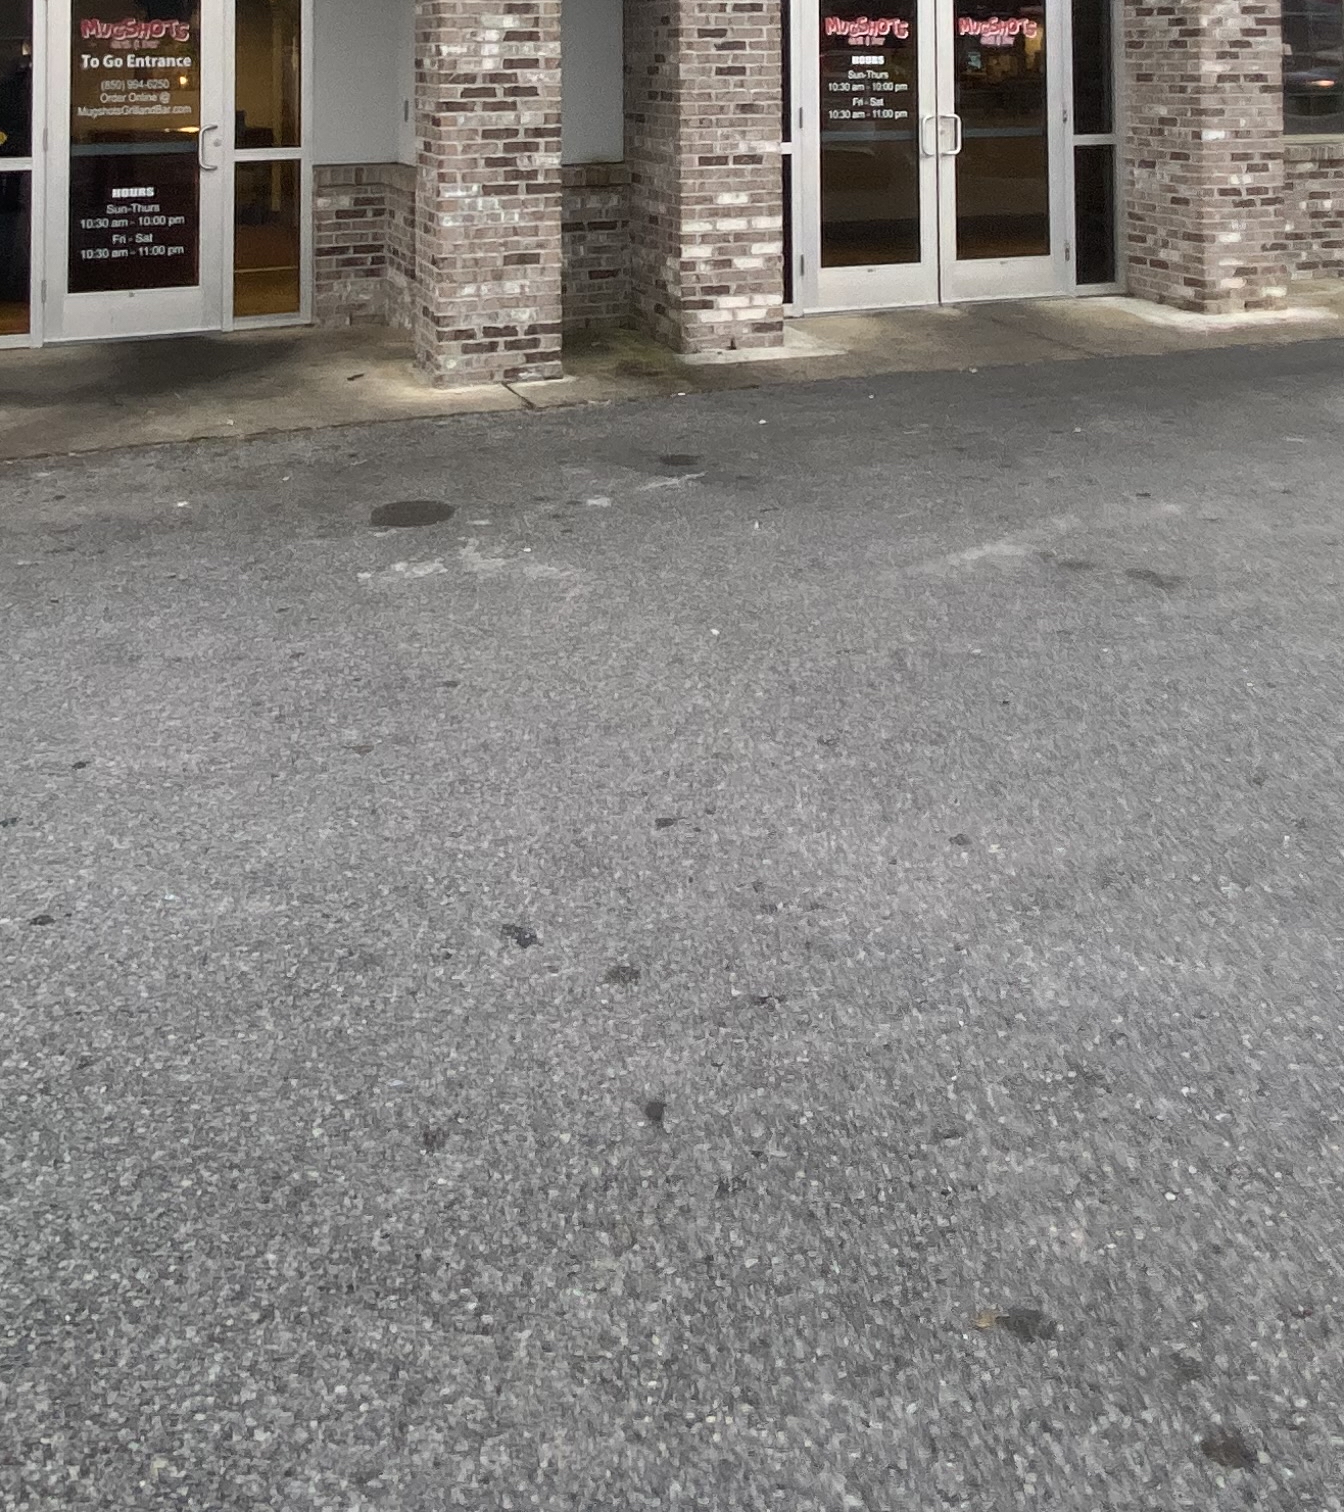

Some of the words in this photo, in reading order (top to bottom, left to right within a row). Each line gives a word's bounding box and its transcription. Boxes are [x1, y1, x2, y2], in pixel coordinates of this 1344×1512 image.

[81, 54, 100, 69] To
[102, 54, 124, 69] Go
[126, 54, 192, 68] Entrance
[99, 92, 127, 104] Order
[128, 91, 158, 103] Online
[851, 97, 864, 107] Fri
[869, 96, 884, 106] Sat
[111, 186, 155, 199] HOURS
[80, 218, 109, 230] 10:30
[111, 218, 129, 228] am
[167, 216, 186, 227] pm
[112, 233, 127, 245] Fri
[135, 232, 153, 243] Sat
[80, 248, 110, 260] 10:30
[111, 248, 129, 258] am
[167, 245, 185, 257] pm
